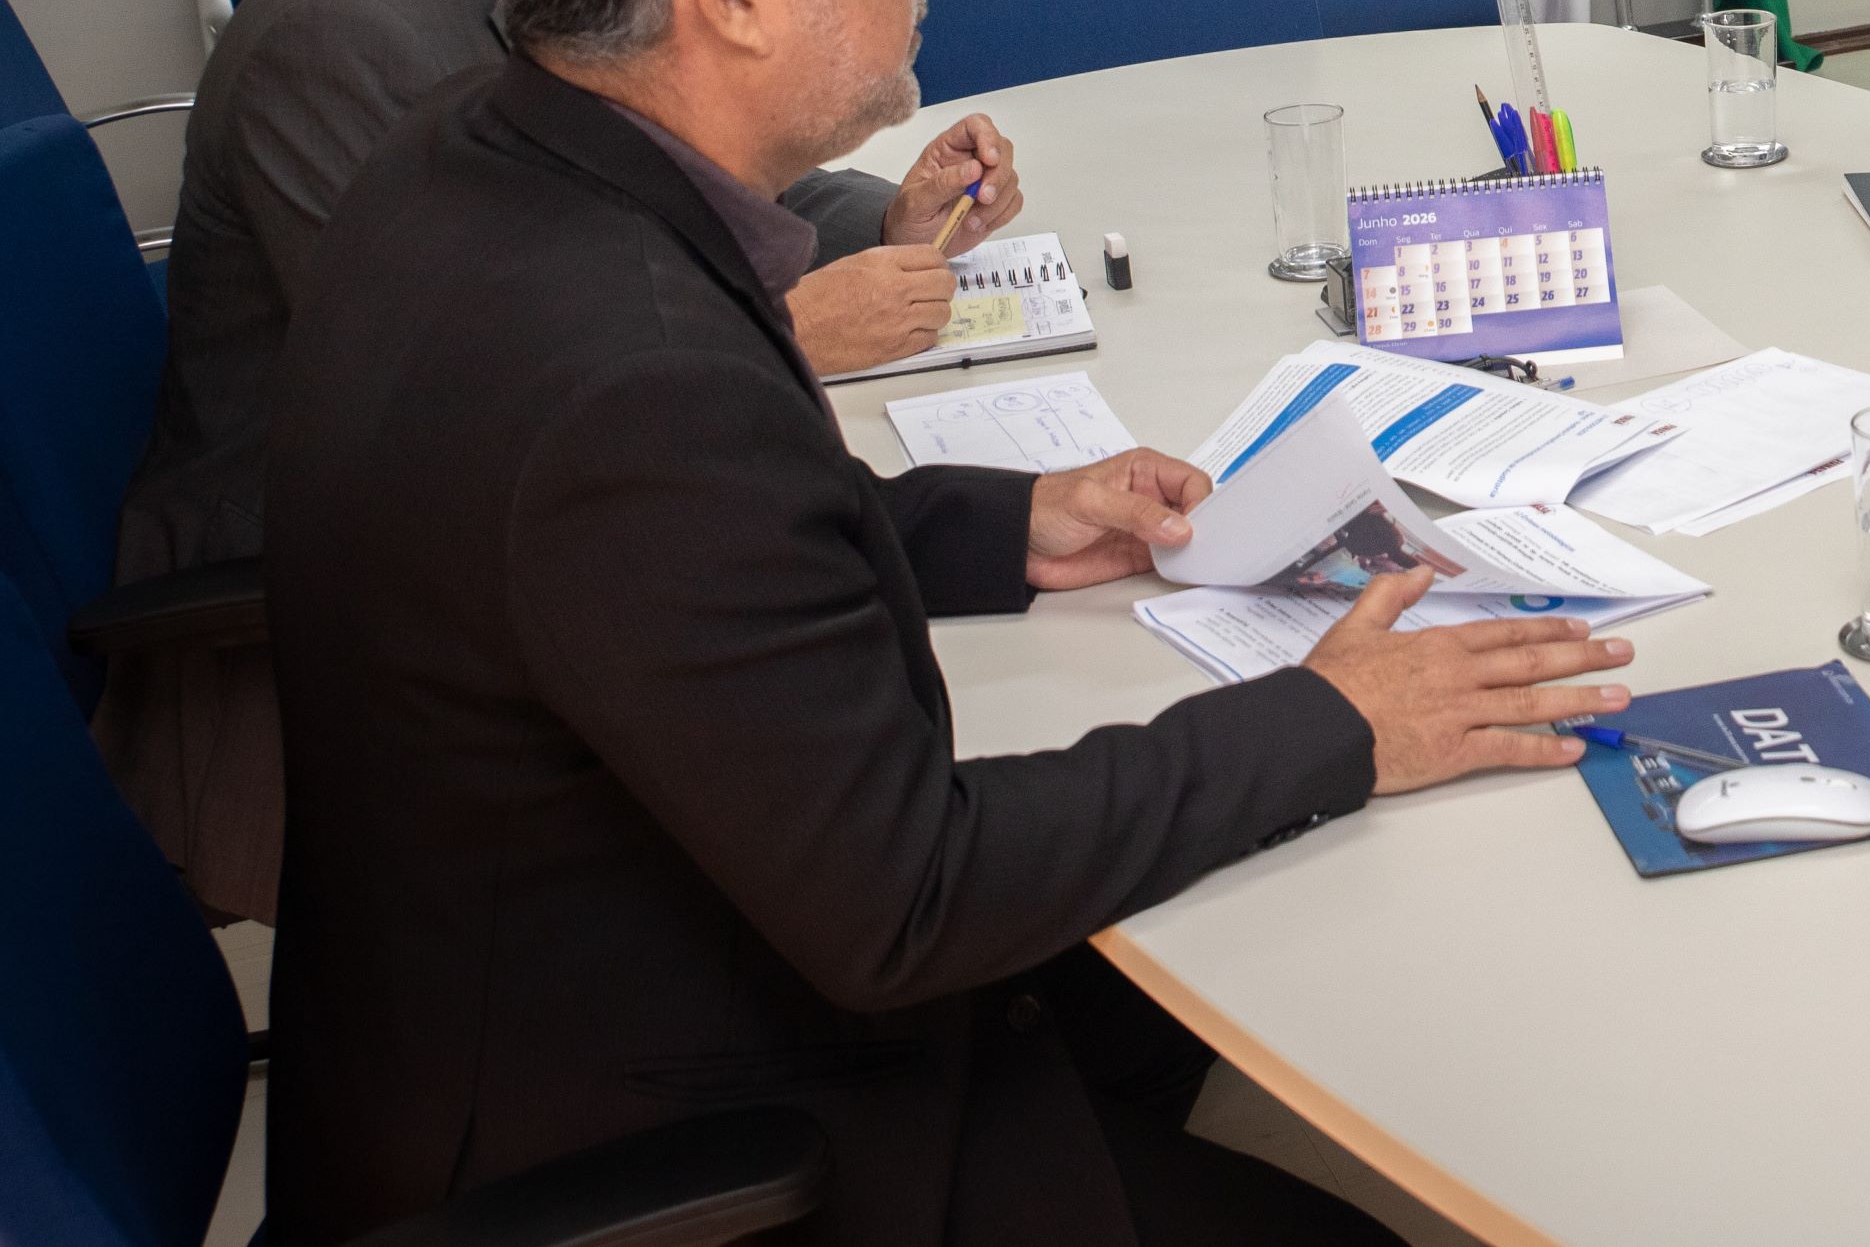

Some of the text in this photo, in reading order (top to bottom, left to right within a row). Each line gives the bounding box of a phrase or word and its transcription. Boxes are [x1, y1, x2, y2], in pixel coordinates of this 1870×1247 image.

[1358, 212, 1437, 229] Junho 2026
[1358, 238, 1378, 246] Dom
[1396, 235, 1411, 244] Seg
[1430, 232, 1441, 240] Ter
[1463, 229, 1480, 237] Qua
[1499, 226, 1512, 234] Qui
[1533, 223, 1547, 231] Sex
[1397, 247, 1402, 258] 1
[1431, 244, 1438, 254] 2
[1466, 241, 1473, 252] 3
[1535, 235, 1542, 245] 5
[1570, 232, 1577, 243] 6
[1363, 269, 1371, 280] 7
[1398, 266, 1405, 277] 8
[1433, 263, 1440, 274] 9
[1469, 260, 1480, 271] 10
[1504, 256, 1513, 267] 11
[1538, 254, 1549, 264] 12
[1573, 250, 1583, 261] 13
[1365, 268, 1587, 299] 14 15 16 17 18 19 20
[1366, 307, 1378, 318] 21
[1402, 304, 1415, 315] 22
[1436, 300, 1449, 311] 23
[1472, 297, 1485, 308] 24
[1507, 294, 1519, 304] 25
[1541, 290, 1554, 301] 26
[1576, 287, 1589, 298] 27
[1368, 325, 1381, 335] 28
[1404, 321, 1416, 332] 29
[1439, 318, 1452, 329] 30
[1730, 707, 1820, 764] DAT
